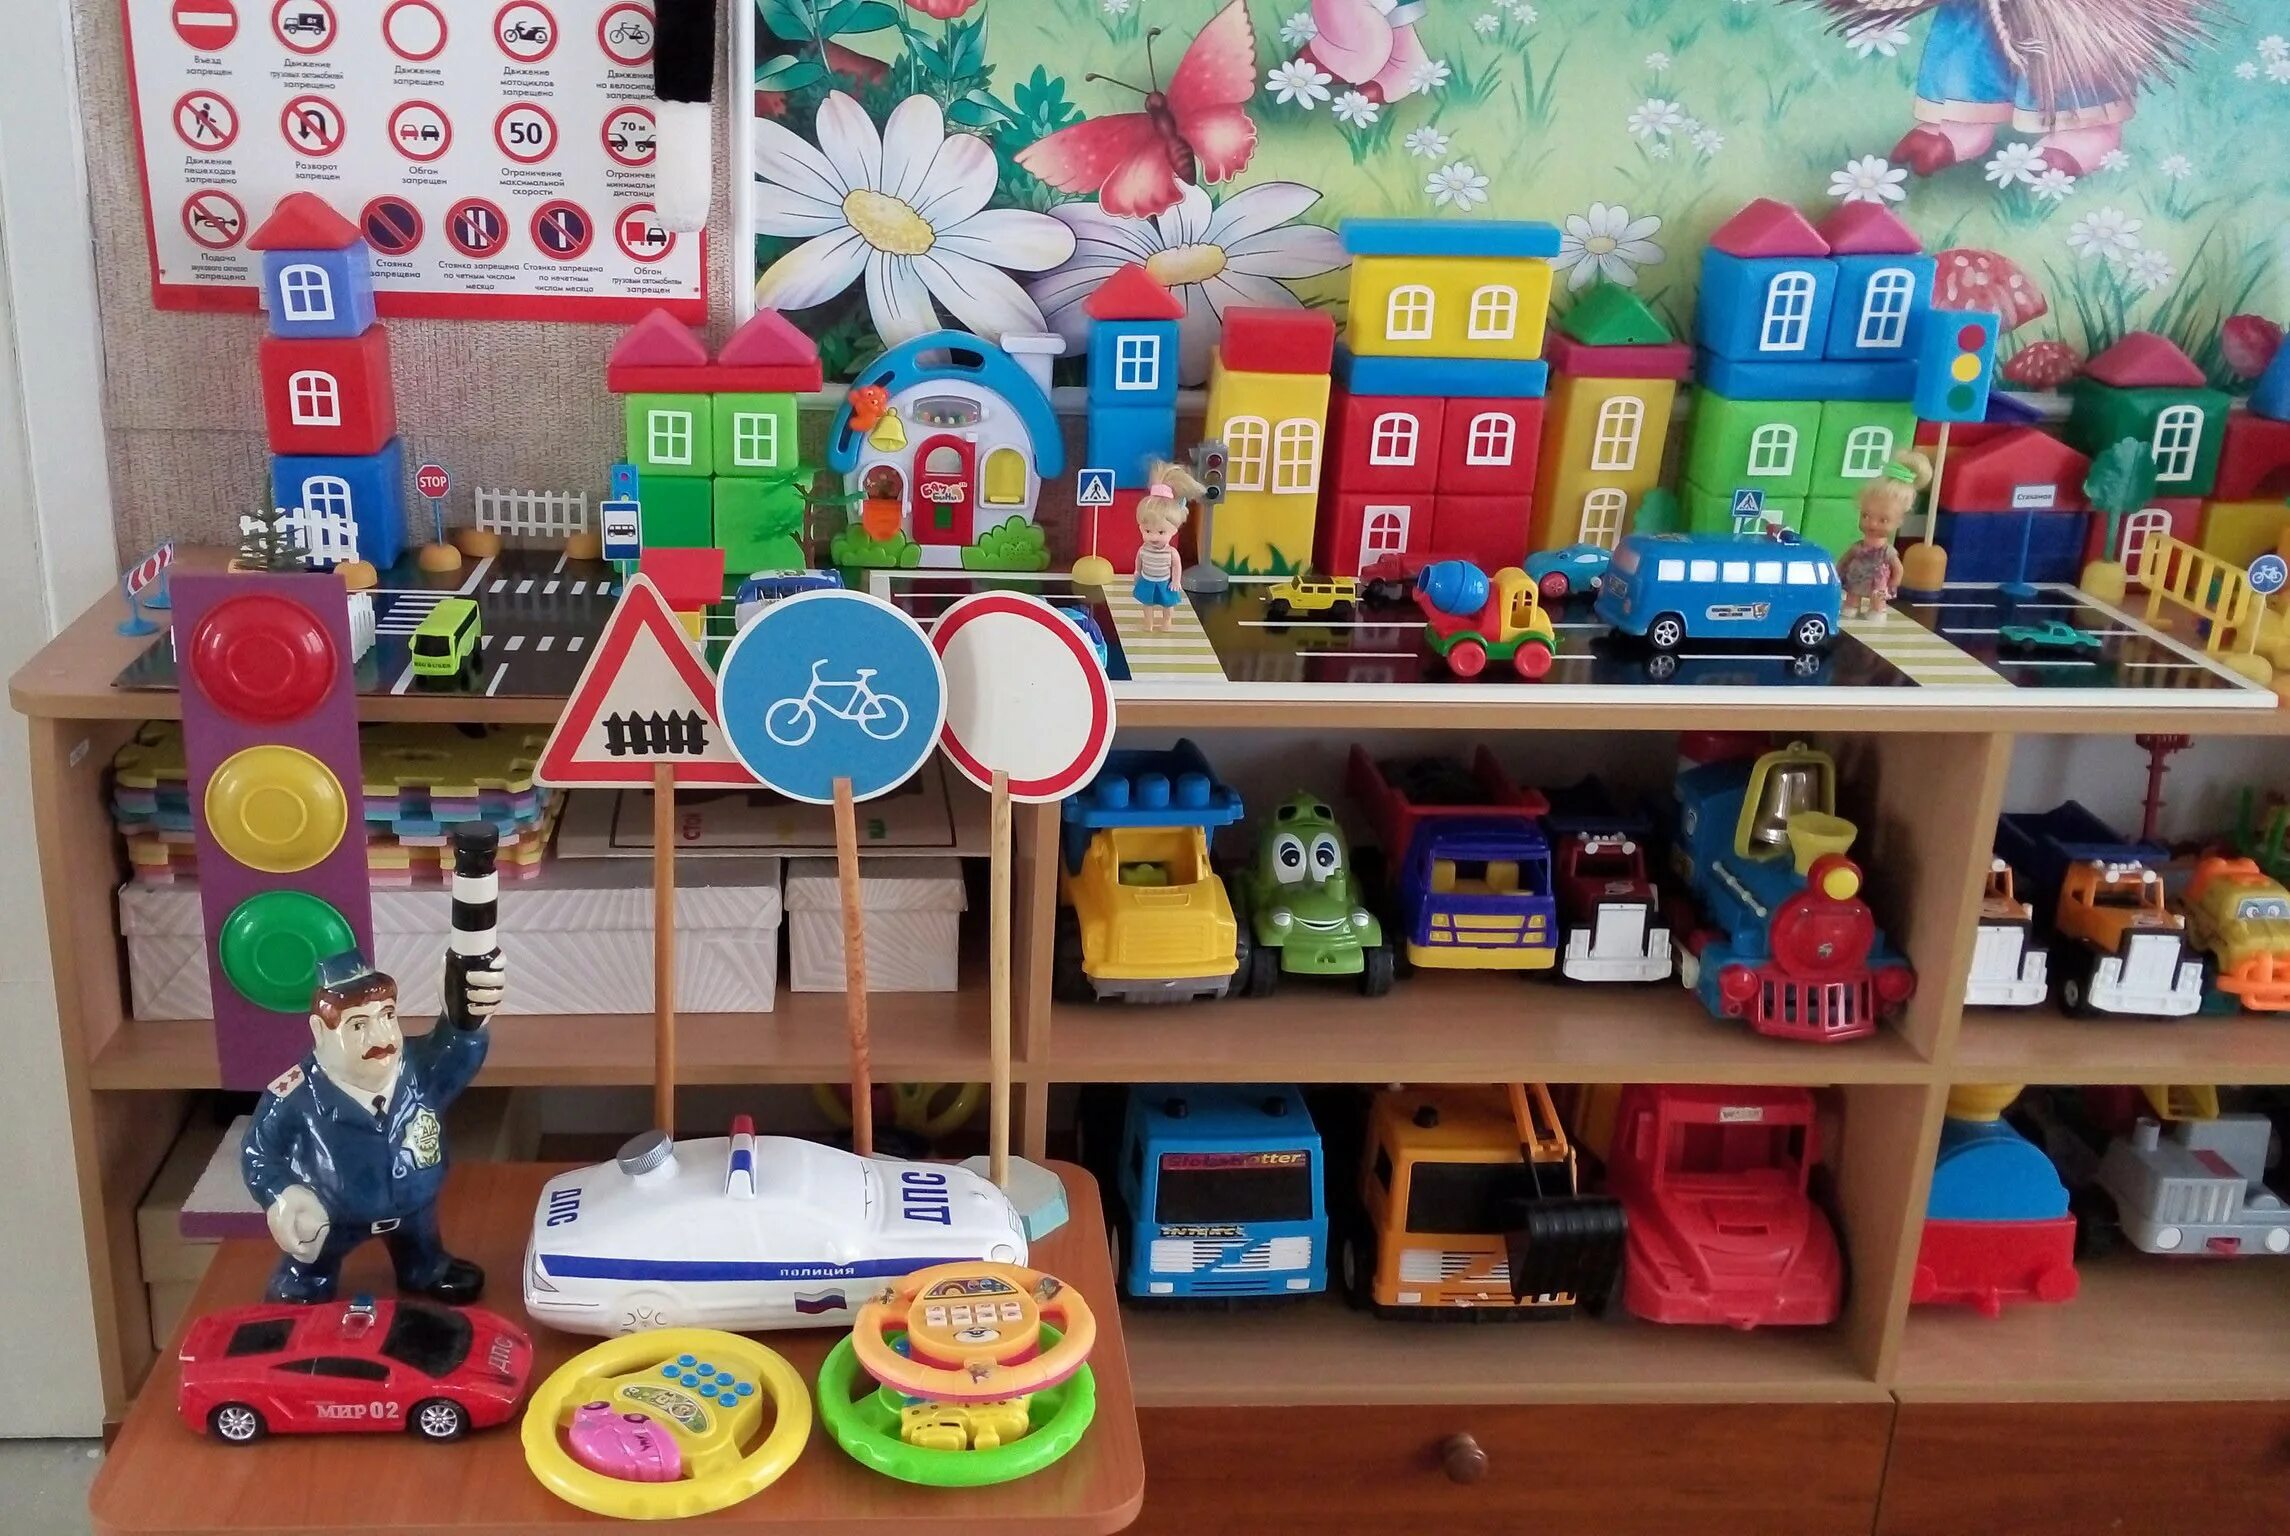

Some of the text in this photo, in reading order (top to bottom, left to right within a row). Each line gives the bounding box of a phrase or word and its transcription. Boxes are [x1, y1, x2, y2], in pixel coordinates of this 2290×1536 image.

[194, 55, 222, 65] Въезд
[284, 58, 332, 68] Движение
[186, 68, 233, 77] запрещен
[394, 65, 441, 75] Движение
[503, 66, 550, 76] Движение
[607, 70, 654, 79] Движение
[283, 82, 336, 90] запрещено
[393, 78, 445, 87] запрещено
[500, 79, 555, 88] мотоциклов
[502, 89, 554, 97] запрещено
[620, 121, 636, 131] 70
[510, 122, 543, 144] 50
[186, 156, 232, 166] Движение
[295, 161, 338, 170] Разворот
[184, 167, 236, 175] пешеходов
[408, 166, 439, 175] Обгон
[501, 168, 562, 178] Ограничение
[185, 176, 237, 185] запрещено
[295, 172, 341, 181] запрещен
[402, 178, 448, 186] запрещен
[500, 179, 565, 187] максимальной
[201, 252, 236, 262] Подача
[376, 259, 413, 268] Стоянка
[438, 261, 520, 271] Стоянка запрещена
[523, 263, 604, 273] Стоянка запрещена
[370, 270, 421, 279] запрещена
[633, 266, 662, 275] Обгон
[195, 272, 246, 281] запрещена
[419, 476, 447, 488] STOP
[901, 1172, 951, 1225] ДПС
[547, 1188, 582, 1227] ДПС
[780, 1267, 855, 1277] полиция
[488, 1335, 513, 1374] ДПС
[316, 1401, 399, 1419] МИР 02
